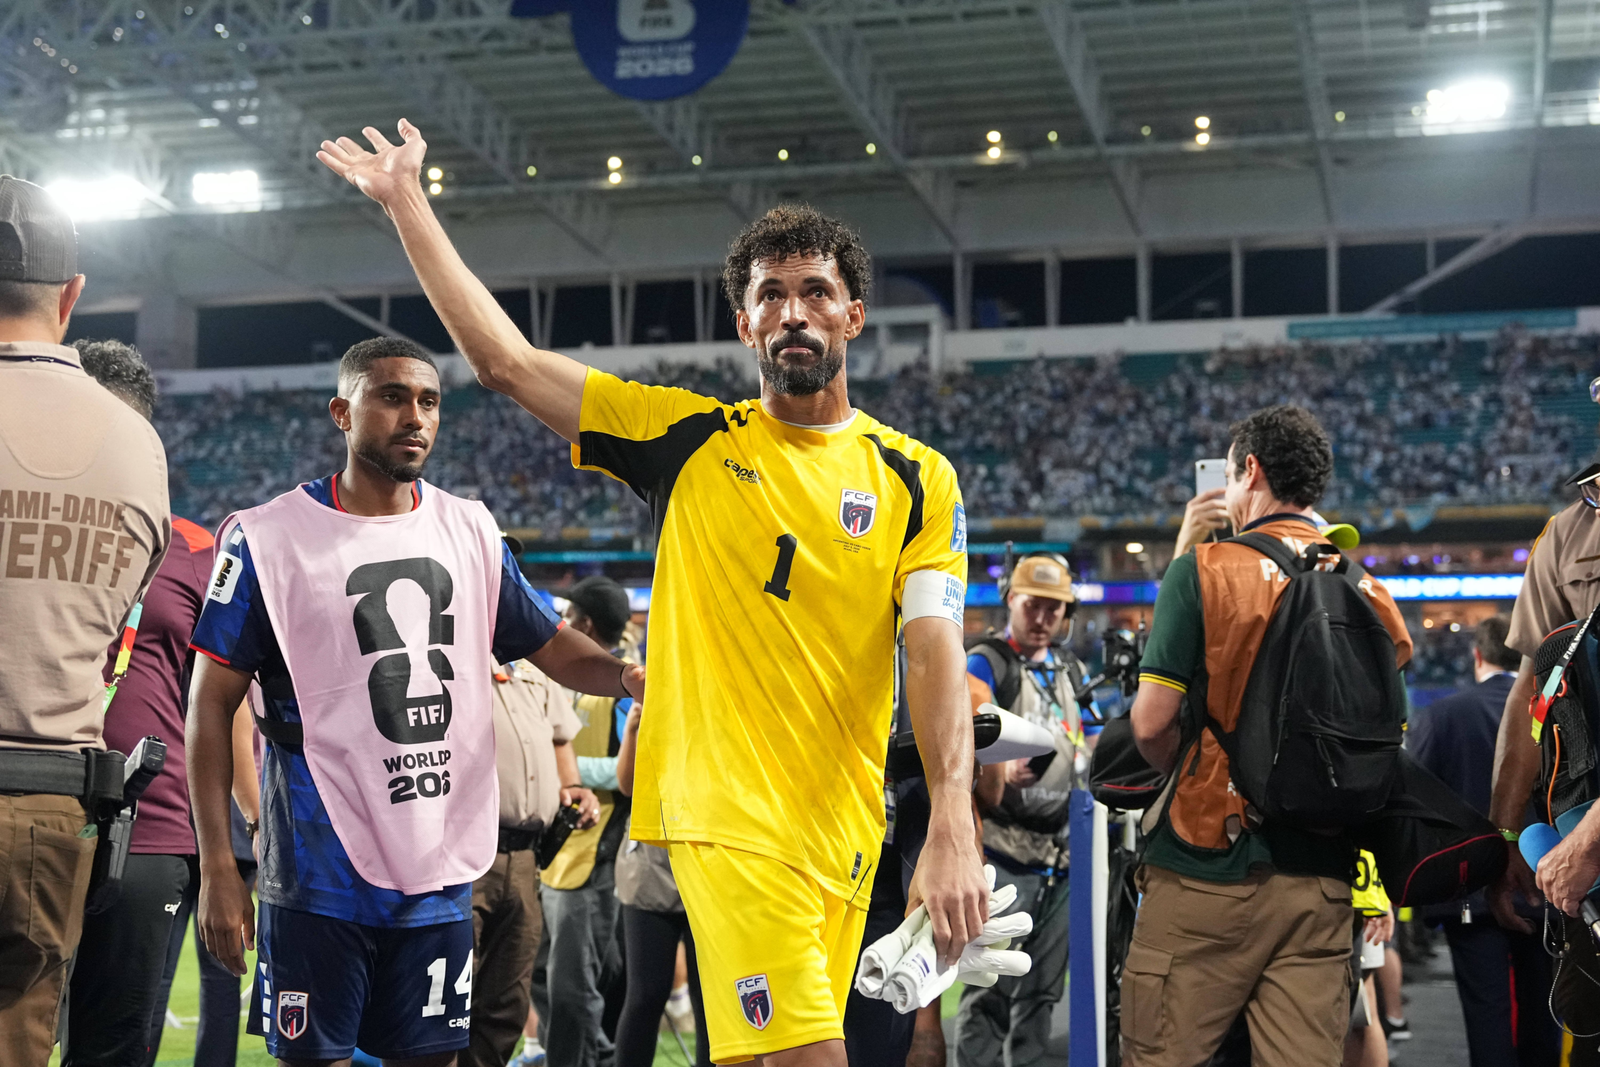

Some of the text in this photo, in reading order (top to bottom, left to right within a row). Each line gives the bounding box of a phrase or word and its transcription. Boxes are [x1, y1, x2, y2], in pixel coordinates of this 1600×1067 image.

[845, 491, 875, 501] FCF
[0, 522, 136, 588] ERIFF
[764, 533, 797, 602] 1
[1563, 642, 1578, 660] FIFA
[422, 948, 473, 1018] 14
[737, 977, 764, 990] FCF
[281, 993, 306, 1002] FCF
